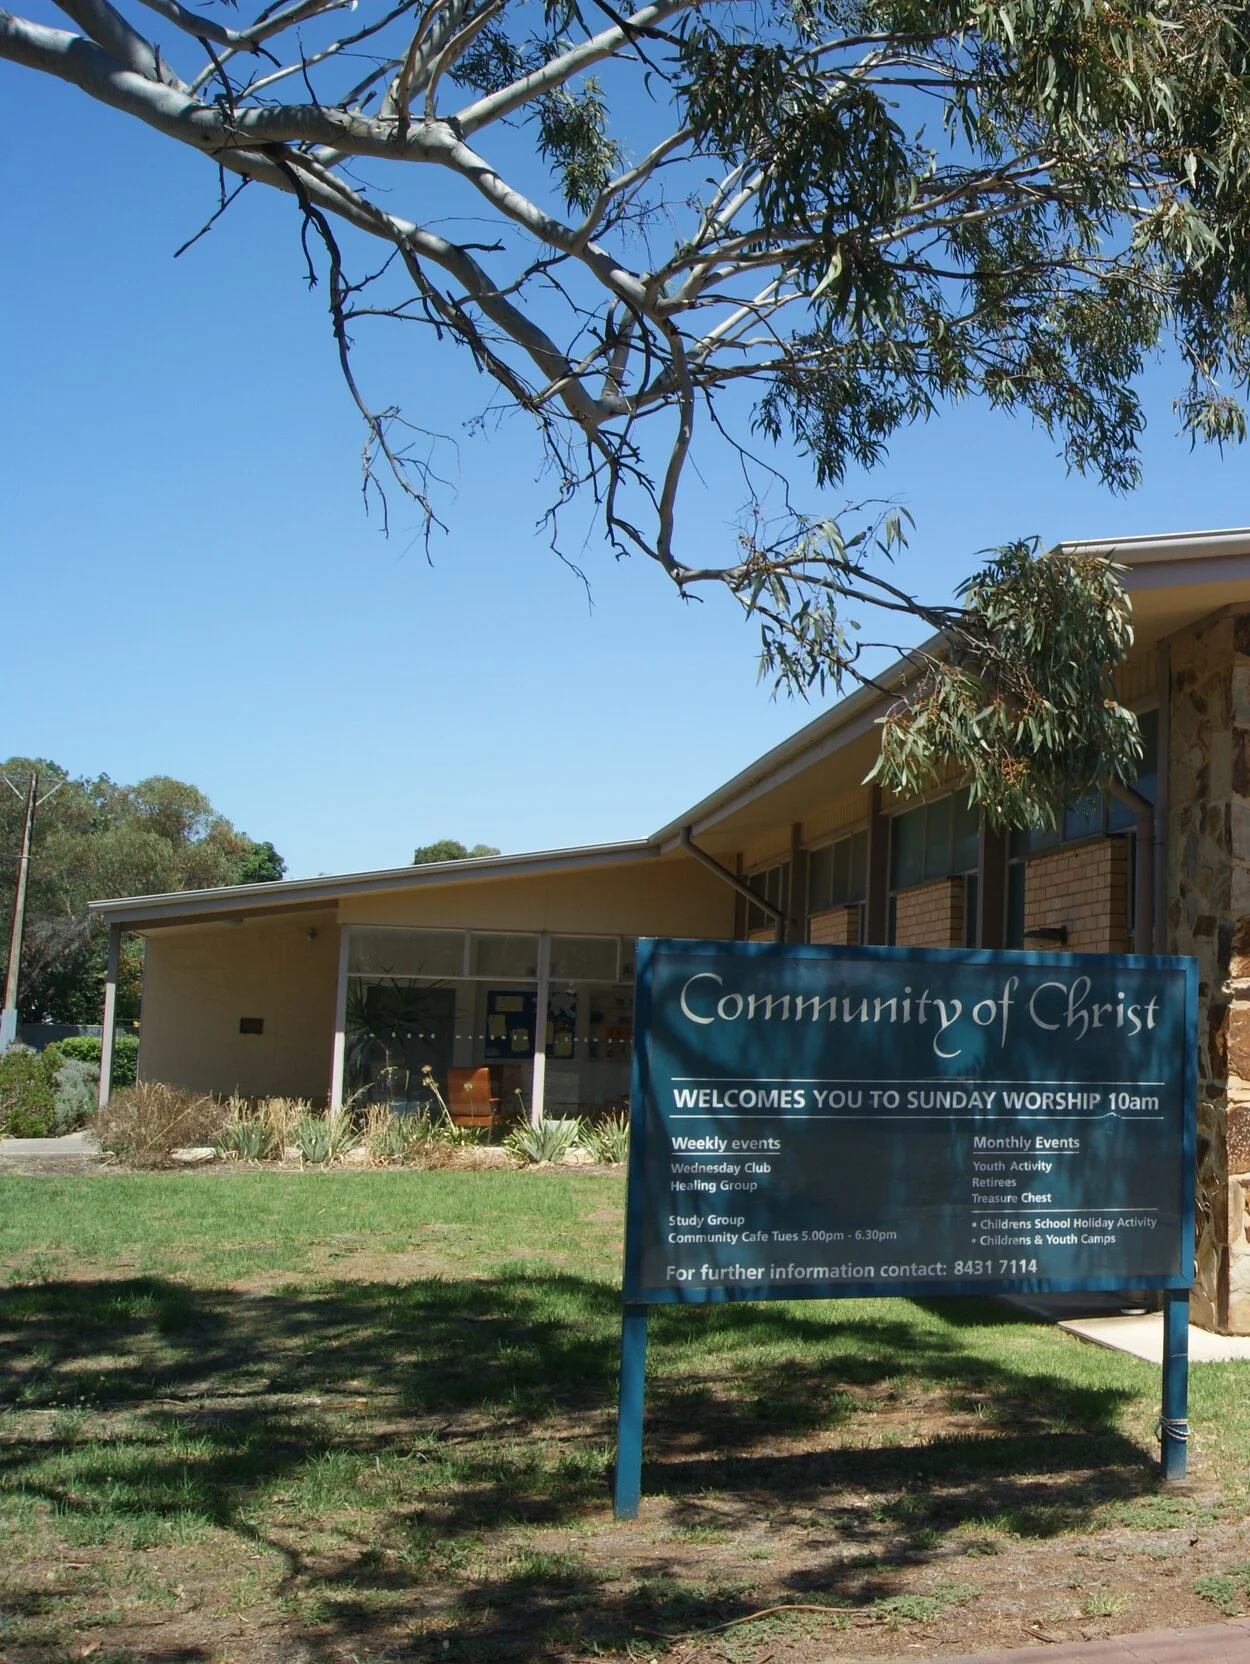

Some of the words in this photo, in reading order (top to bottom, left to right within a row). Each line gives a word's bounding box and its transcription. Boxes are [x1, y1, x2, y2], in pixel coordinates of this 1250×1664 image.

[680, 972, 963, 1058] Community
[972, 975, 1020, 1049] of
[1029, 975, 1160, 1041] Christ
[673, 1088, 806, 1109] WELCOMES
[812, 1090, 862, 1109] YOU
[869, 1090, 900, 1109] TO
[907, 1090, 996, 1109] SUNDAY
[1002, 1091, 1101, 1110] WORSHIP
[1109, 1092, 1159, 1110] 10am
[672, 1136, 728, 1152] Weekly
[731, 1137, 781, 1149] events
[973, 1136, 1032, 1151] Monthly
[1035, 1136, 1080, 1149] Events
[671, 1162, 741, 1176] Wednesday
[744, 1162, 772, 1174] Club
[973, 1161, 1006, 1172] Youth
[1010, 1161, 1052, 1173] Activity
[670, 1179, 717, 1193] Healing
[720, 1180, 758, 1192] Group
[972, 1177, 1017, 1188] Retirees
[972, 1193, 1018, 1204] Treasure
[1021, 1192, 1052, 1203] Chest
[668, 1214, 705, 1228] Study
[707, 1214, 745, 1227] Group
[980, 1218, 1032, 1230] Childrens
[1034, 1218, 1071, 1229] School
[1073, 1218, 1115, 1230] Holiday
[1117, 1217, 1157, 1229] Activity
[668, 1231, 738, 1245] Community
[741, 1231, 769, 1243] Cafe
[772, 1231, 799, 1242] Tues
[801, 1230, 844, 1242] 5.00pm
[855, 1229, 897, 1242] 6.30pm
[980, 1235, 1032, 1246] Childrens
[1034, 1235, 1043, 1245] &
[1046, 1234, 1078, 1244] Youth
[1080, 1234, 1116, 1245] Camps
[666, 1265, 695, 1281] For
[700, 1264, 765, 1280] further
[770, 1262, 875, 1280] information
[880, 1262, 947, 1278] contact:
[954, 1260, 992, 1275] 8431
[999, 1259, 1038, 1274] 7114
